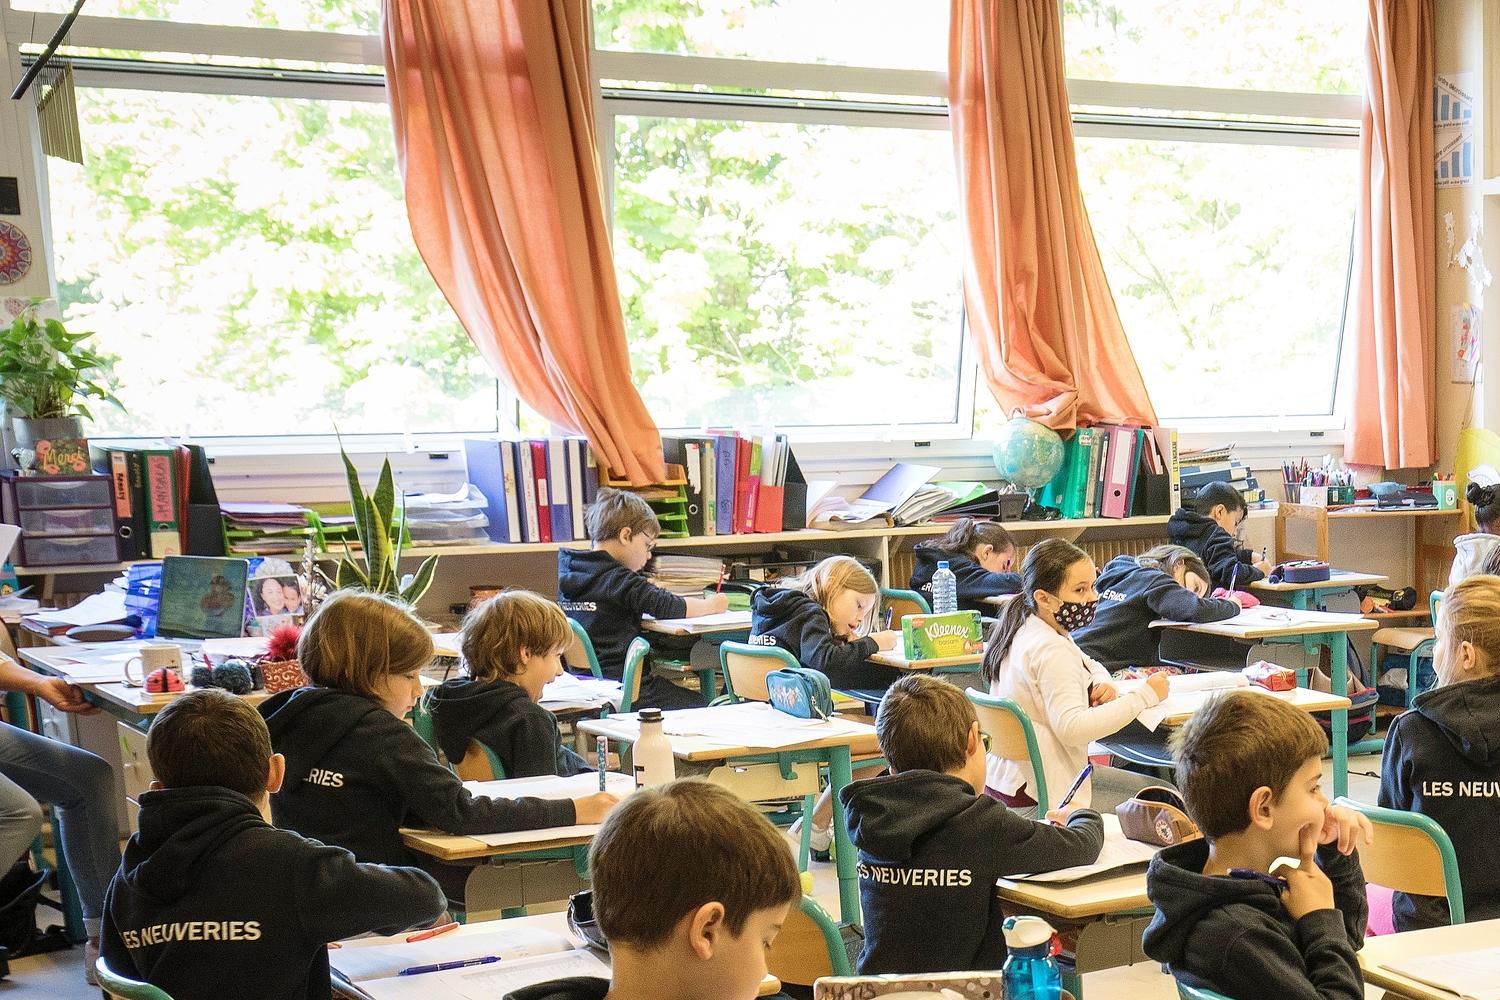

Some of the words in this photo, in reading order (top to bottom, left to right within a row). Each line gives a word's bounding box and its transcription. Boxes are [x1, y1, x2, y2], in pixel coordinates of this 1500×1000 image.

[924, 622, 969, 641] Kleenex
[303, 768, 344, 787] RIES
[1422, 781, 1453, 797] LES
[871, 865, 973, 887] NEUVERIES
[141, 921, 262, 947] NEUVERIES
